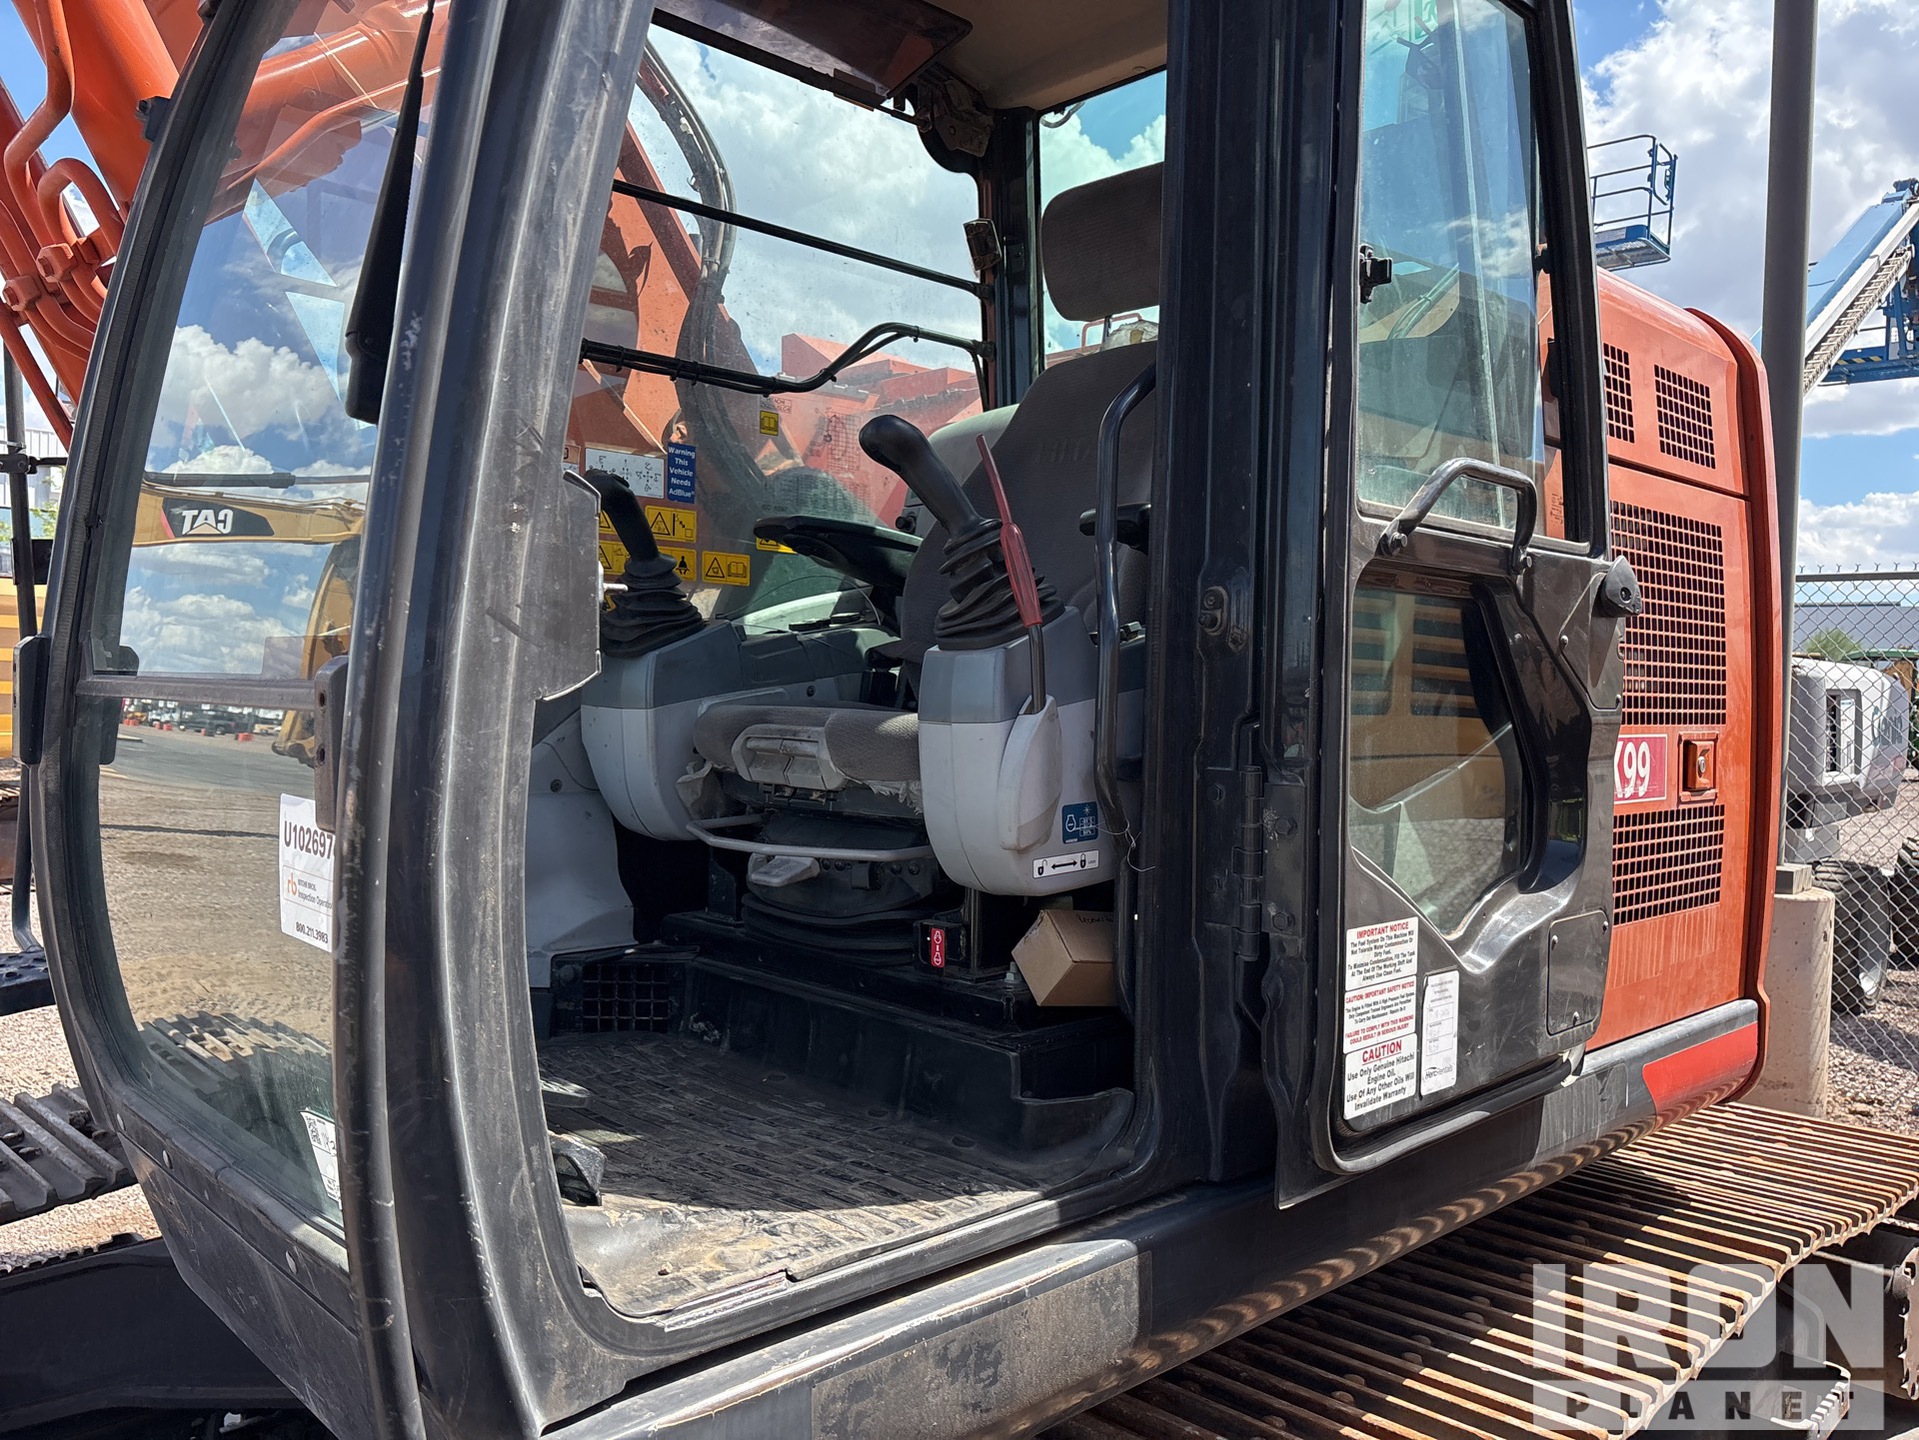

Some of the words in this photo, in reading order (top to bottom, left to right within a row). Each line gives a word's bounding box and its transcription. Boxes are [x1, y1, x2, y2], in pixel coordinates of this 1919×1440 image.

[668, 446, 695, 459] Warning
[675, 458, 688, 466] This
[669, 467, 693, 477] Vehicle
[671, 477, 691, 487] Needs
[1357, 926, 1388, 939] IMPORTANT
[1390, 922, 1408, 932] NOTICE
[1362, 1040, 1402, 1062] CAUTION
[1347, 1073, 1358, 1081] Use
[1360, 1066, 1372, 1077] Only
[1373, 1060, 1395, 1072] Genuine
[1396, 1052, 1414, 1065] Hitachi
[1367, 1073, 1385, 1085] Engine
[1347, 1093, 1357, 1102] Use
[1359, 1089, 1365, 1098] Of
[1366, 1087, 1376, 1095] Any
[1378, 1081, 1393, 1091] Other
[1394, 1077, 1404, 1085] Oils
[1405, 1072, 1414, 1081] Will
[1355, 1096, 1381, 1111] Invalidate
[1383, 1087, 1406, 1099] Warranty
